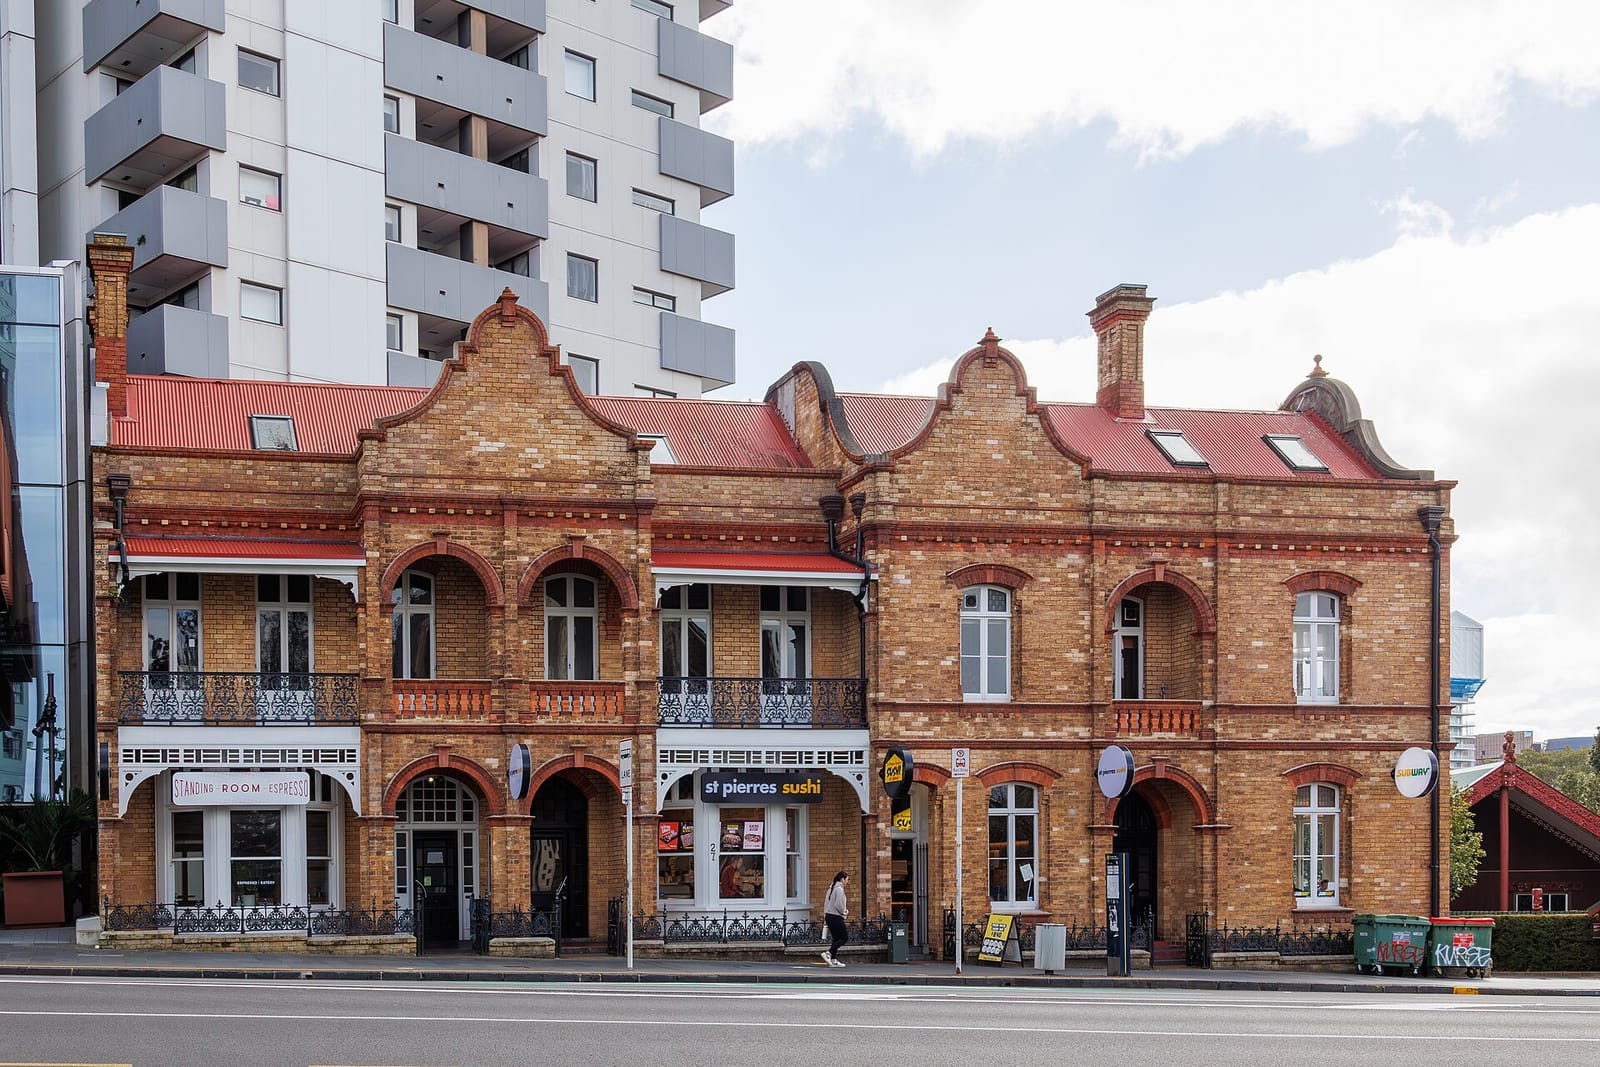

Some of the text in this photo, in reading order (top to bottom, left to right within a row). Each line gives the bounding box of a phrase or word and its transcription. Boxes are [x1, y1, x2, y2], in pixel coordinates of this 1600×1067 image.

[1396, 767, 1431, 778] SUBWAY
[174, 779, 309, 798] STANDING ROOM ESPRESSO
[705, 778, 820, 798] st pierres sushi
